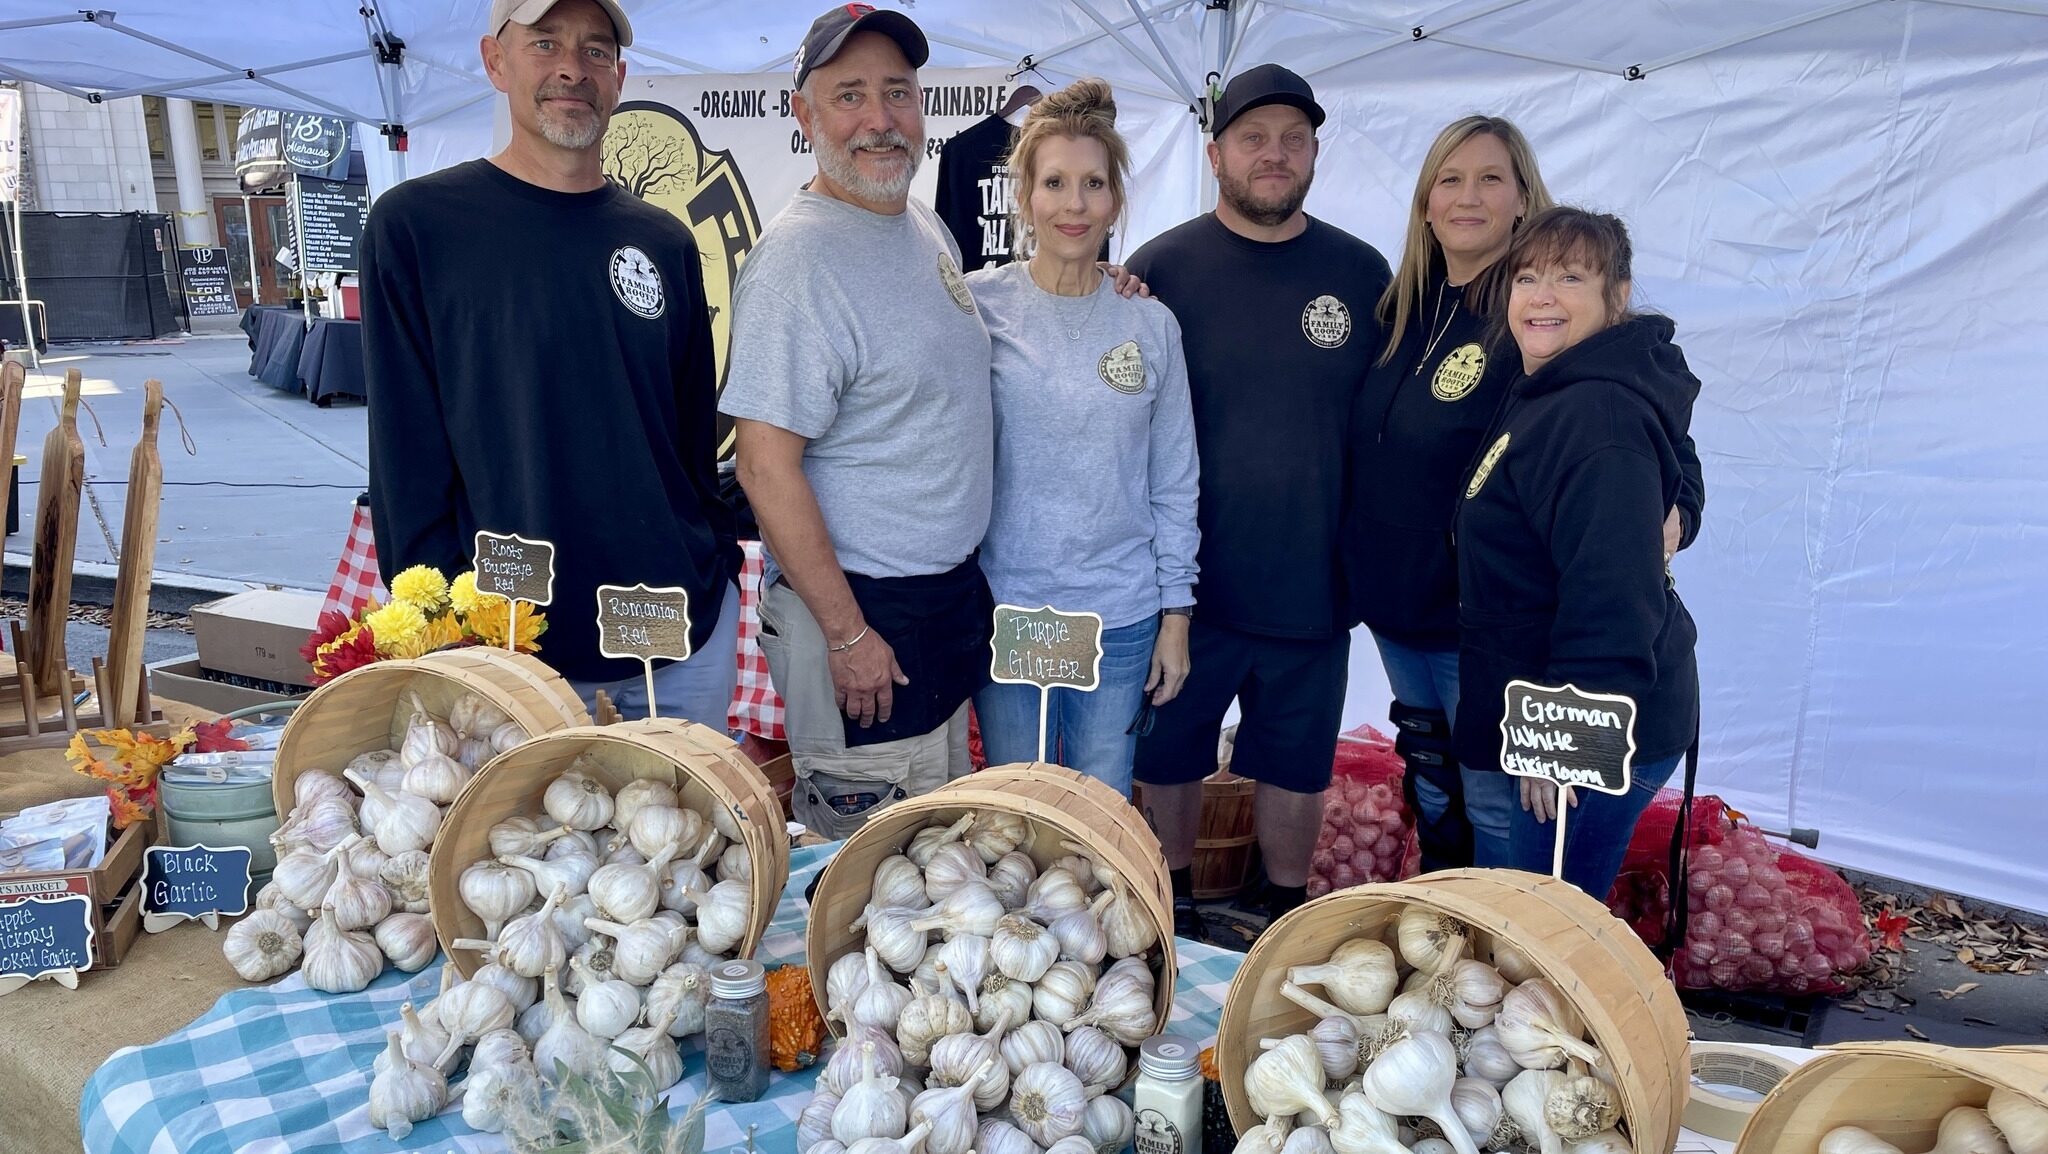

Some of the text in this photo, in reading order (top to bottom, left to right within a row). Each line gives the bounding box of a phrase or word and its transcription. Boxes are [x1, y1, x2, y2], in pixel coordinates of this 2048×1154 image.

[693, 90, 766, 118] -ORGANIC
[923, 86, 1006, 116] TAINABLE
[286, 141, 330, 157] Alehouse
[621, 275, 657, 295] FAMILY
[626, 286, 656, 302] ROOTS
[191, 294, 231, 303] LEASE
[1311, 320, 1344, 329] FAMILY
[1440, 377, 1466, 388] ROOTS
[1442, 369, 1473, 382] FAMILY
[481, 557, 533, 581] Buckeye
[494, 576, 515, 592] Red
[609, 597, 681, 621] Romanian
[618, 625, 651, 646] Red
[1522, 695, 1622, 729] German
[1509, 724, 1578, 751] White
[163, 852, 218, 874] Black
[15, 881, 61, 893] MARKET
[154, 880, 217, 906] Garlic
[0, 925, 55, 949] ickory
[41, 948, 79, 967] Garlic
[1136, 1135, 1172, 1153] FAMILY
